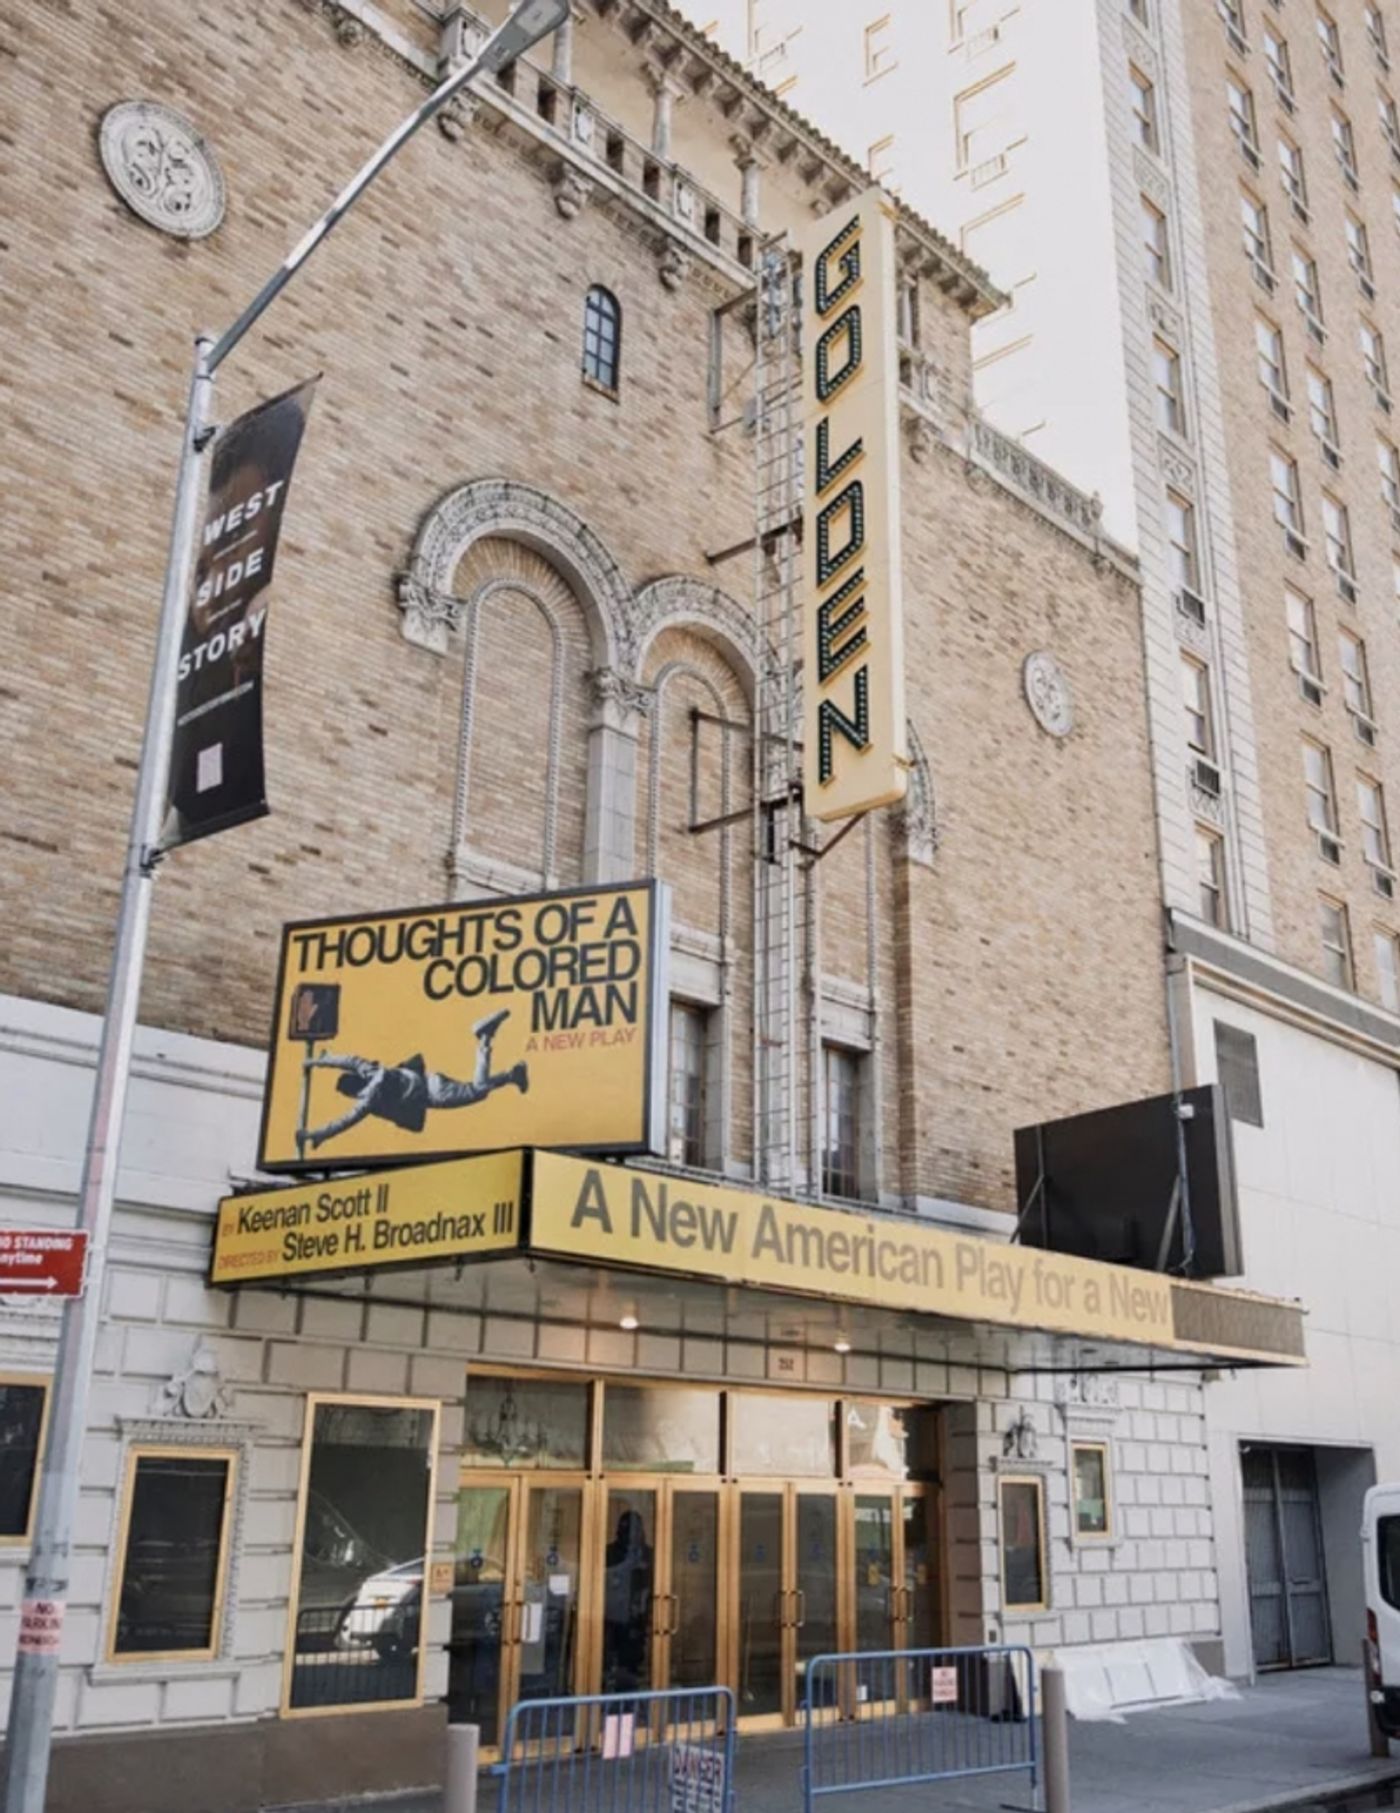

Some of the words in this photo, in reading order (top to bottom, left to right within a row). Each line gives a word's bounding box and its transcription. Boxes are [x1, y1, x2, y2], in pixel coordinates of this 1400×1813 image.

[203, 480, 284, 545] WEST
[815, 213, 868, 785] GOLDEN
[196, 547, 264, 607] SIDE
[177, 608, 266, 681] STORY
[293, 909, 522, 972] THOUGHTS
[534, 900, 597, 946] OF
[603, 896, 639, 939] A
[423, 939, 641, 1000] COLORED
[531, 982, 638, 1033] MAN
[525, 1036, 539, 1053] A
[543, 1031, 586, 1051] NEW
[590, 1027, 636, 1048] PLAY
[237, 1202, 310, 1235] Keenan
[316, 1188, 371, 1223] Scott
[376, 1183, 390, 1213] II
[282, 1231, 339, 1262] Steve
[345, 1222, 366, 1252] H.
[374, 1211, 485, 1250] Broadnax
[493, 1201, 514, 1235] III
[14, 1236, 74, 1251] STANDING
[570, 1168, 613, 1235] A
[630, 1177, 738, 1254] New
[751, 1203, 944, 1290] American
[955, 1242, 1025, 1316] Play
[1033, 1257, 1076, 1311] for
[1083, 1281, 1101, 1316] a
[1108, 1273, 1170, 1325] New
